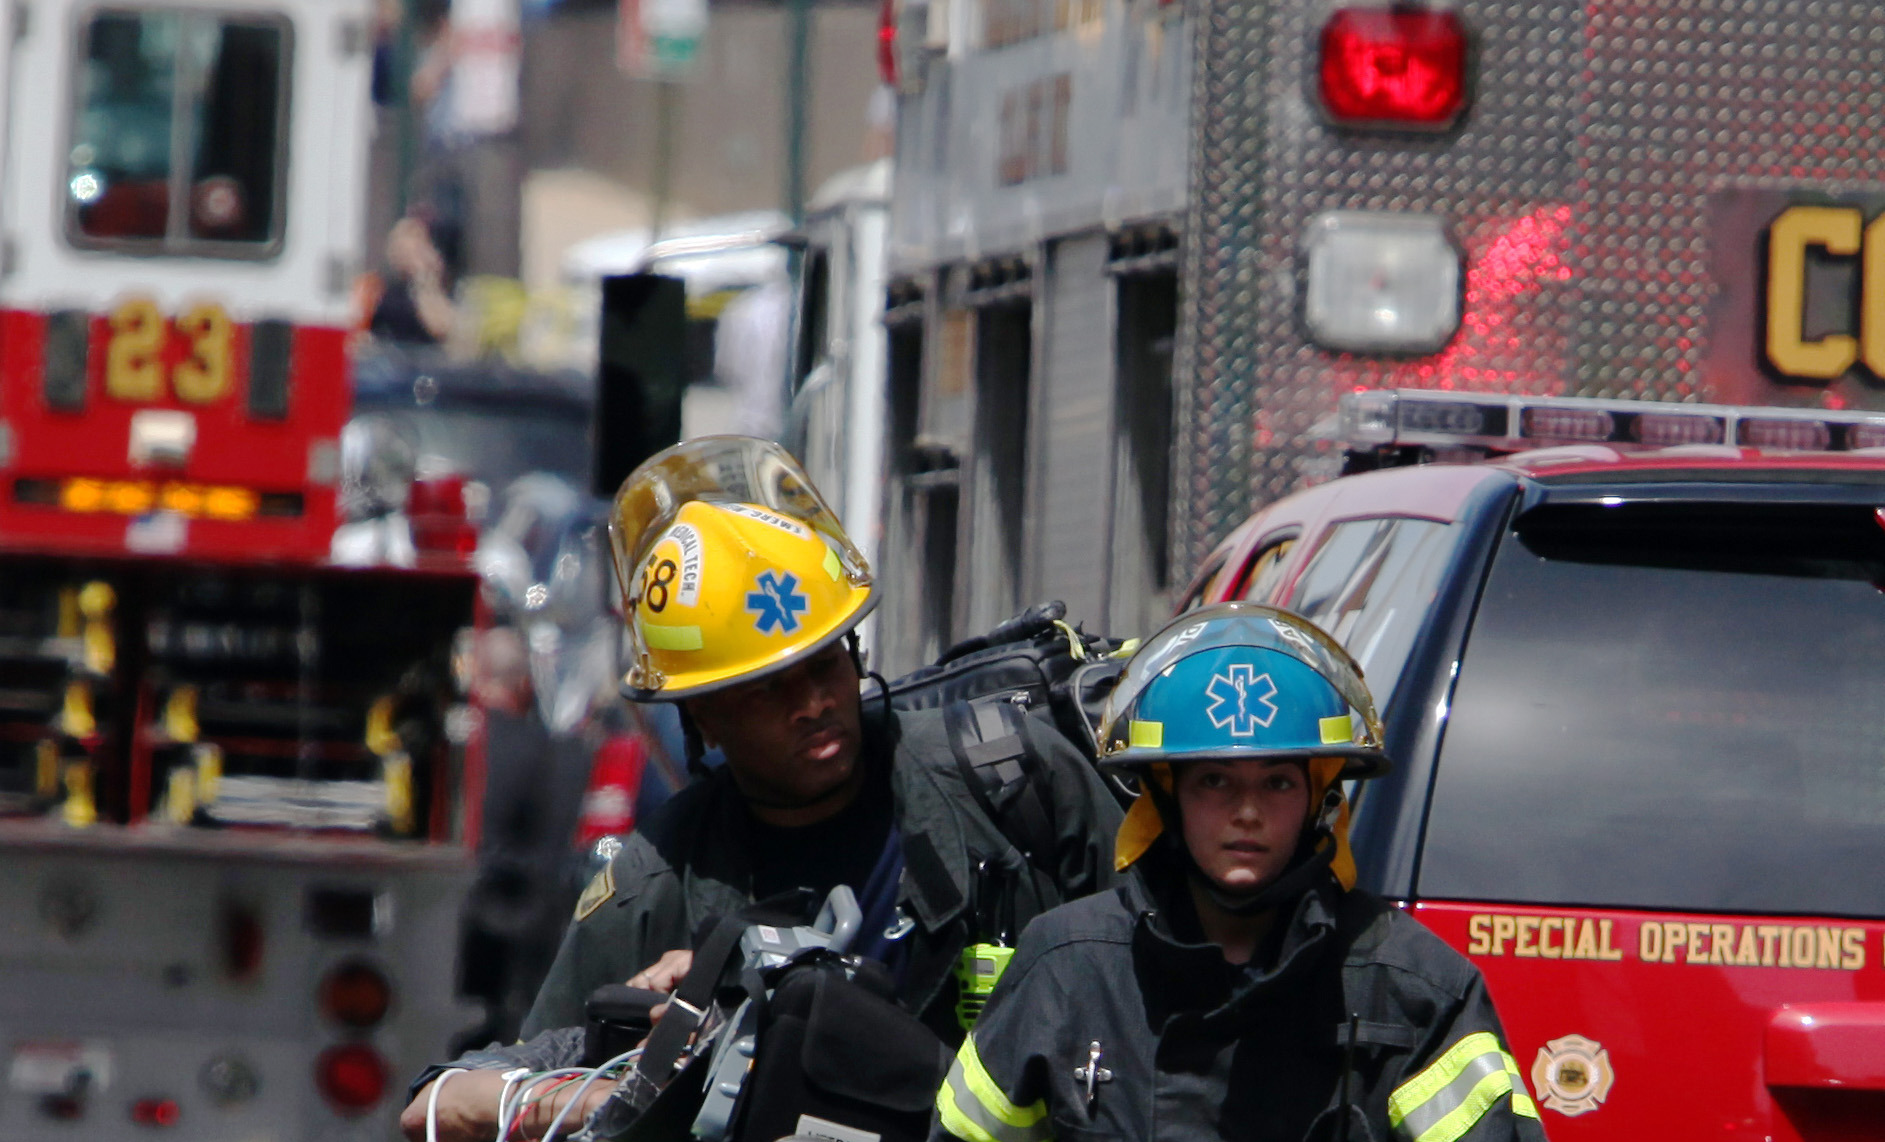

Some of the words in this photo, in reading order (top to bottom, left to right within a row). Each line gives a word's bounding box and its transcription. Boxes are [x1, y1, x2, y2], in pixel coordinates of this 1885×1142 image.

[1765, 205, 1885, 380] C
[109, 302, 230, 401] 23
[1468, 914, 1622, 961] SPECIAL
[1640, 921, 1867, 970] OPERATIONS
